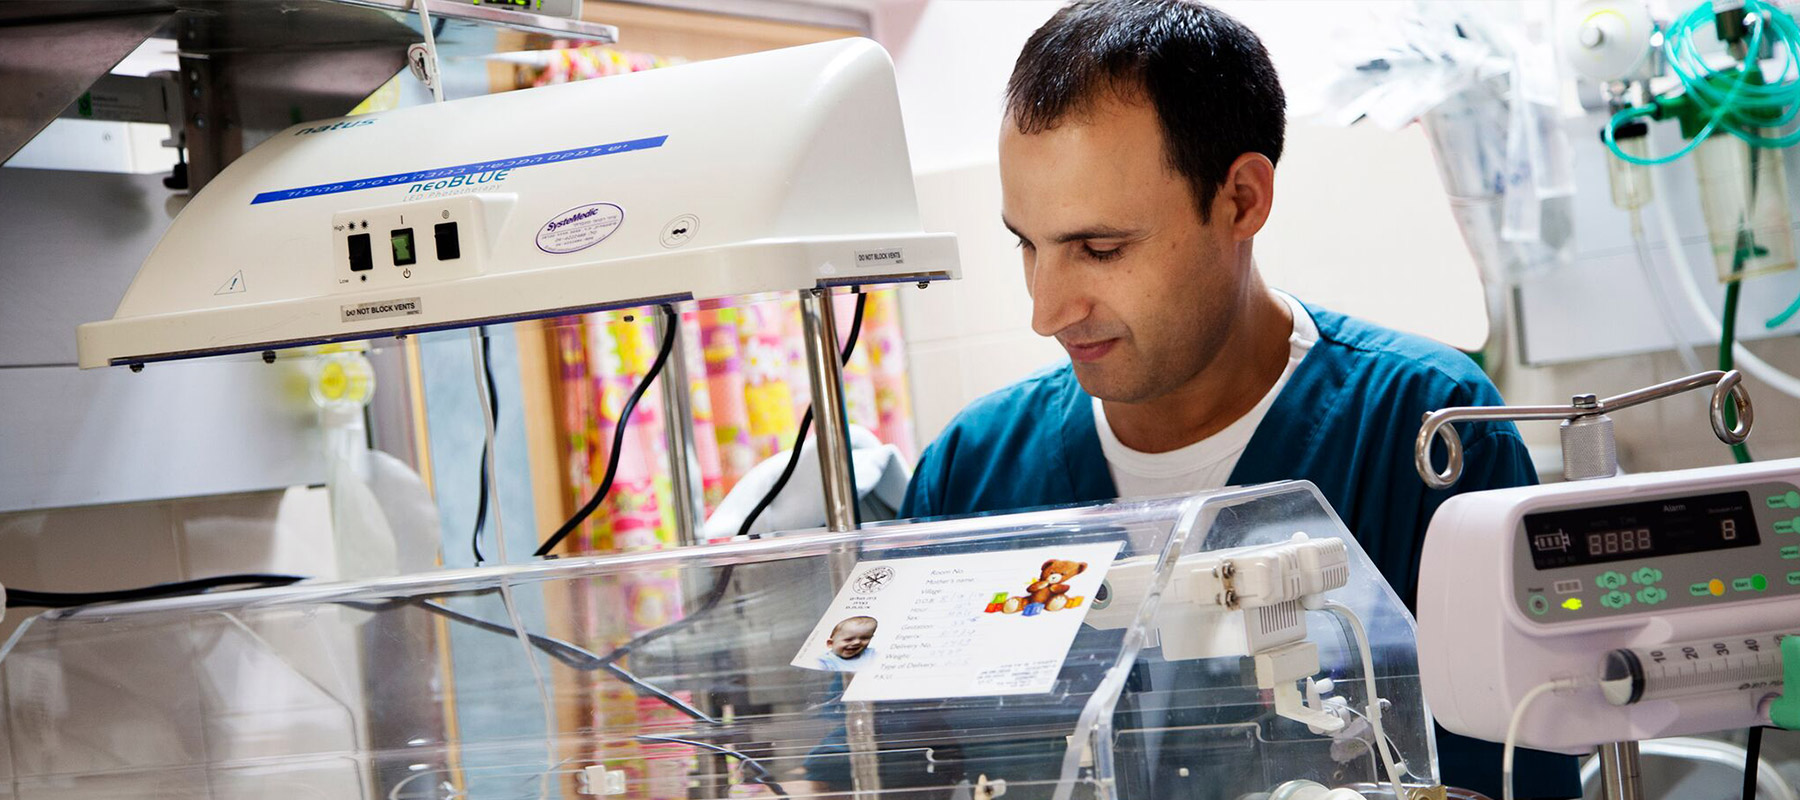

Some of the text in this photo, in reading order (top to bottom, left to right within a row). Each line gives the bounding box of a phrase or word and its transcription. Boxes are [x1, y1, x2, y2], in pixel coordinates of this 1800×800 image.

[408, 168, 513, 194] neoBLUE
[546, 206, 600, 232] SysteMedic
[345, 302, 415, 317] DO NOT BLOCK VENTS
[1663, 502, 1687, 513] Alarm
[1650, 650, 1667, 663] 10
[1682, 646, 1700, 660] 20
[1713, 642, 1730, 656] 30
[1744, 638, 1760, 652] 40
